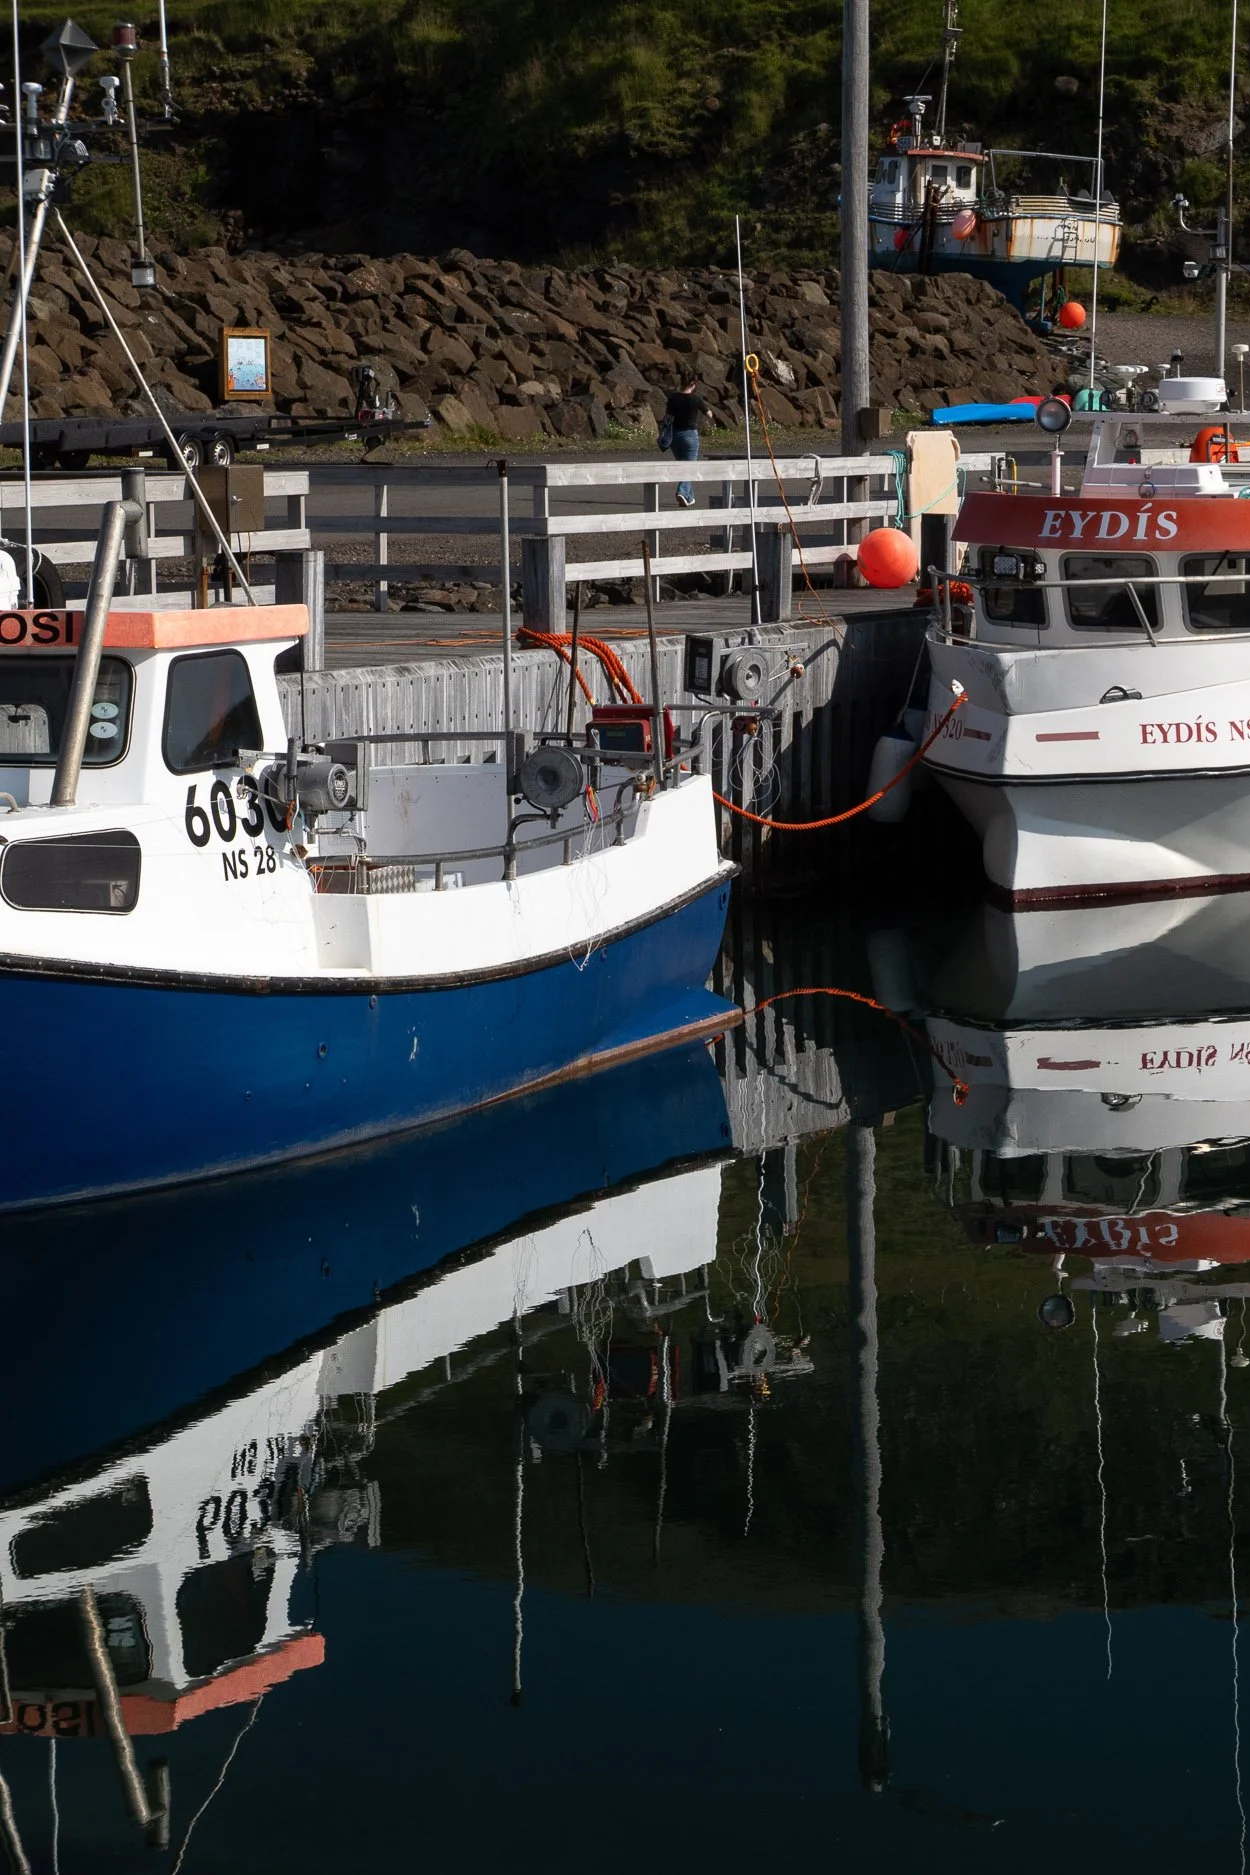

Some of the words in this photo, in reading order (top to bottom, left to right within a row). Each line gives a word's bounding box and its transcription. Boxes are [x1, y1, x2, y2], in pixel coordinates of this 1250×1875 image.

[1038, 502, 1179, 541] EYDÍS
[0, 612, 74, 644] OSI
[1139, 714, 1218, 745] EYDÍS
[222, 849, 250, 882] NS
[254, 844, 277, 877] 28
